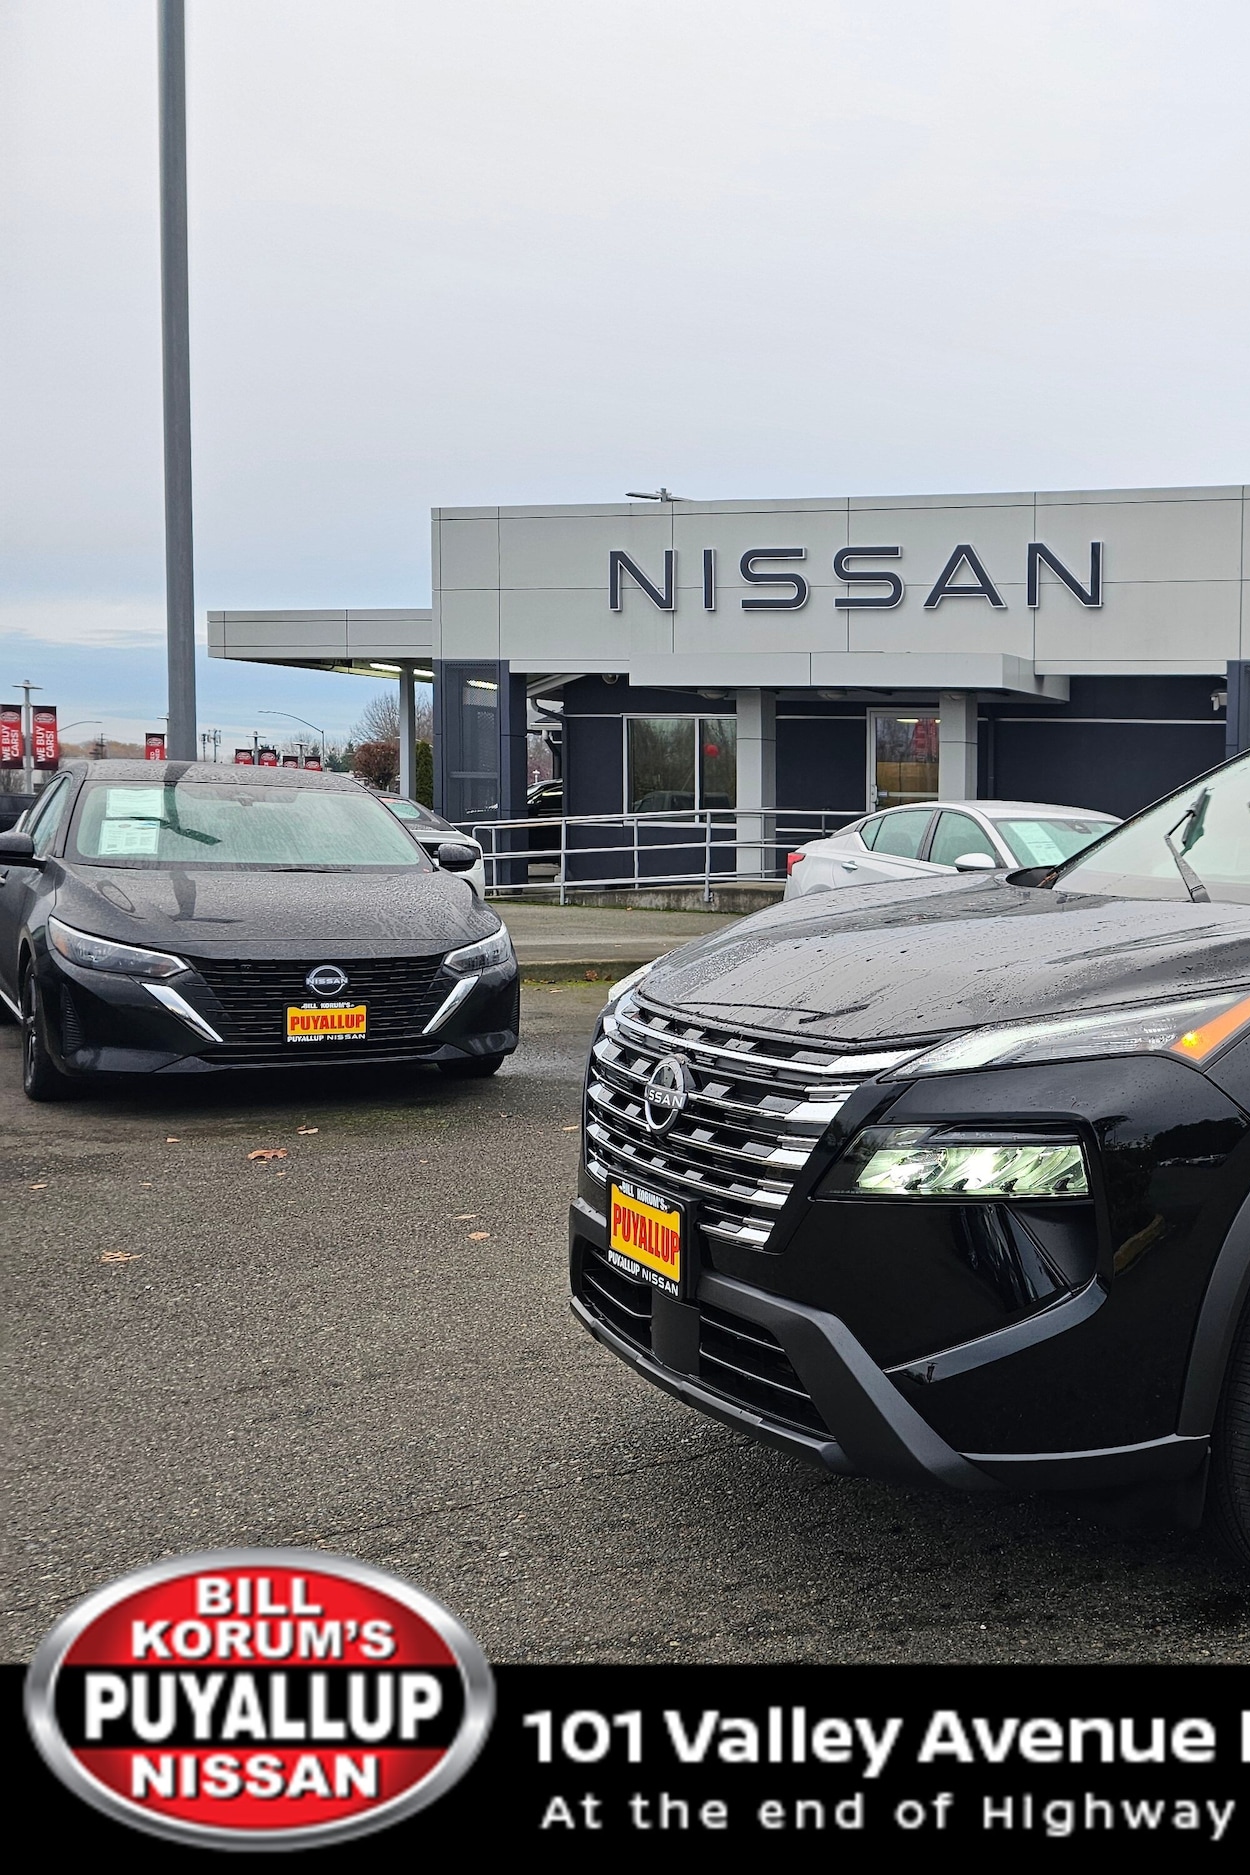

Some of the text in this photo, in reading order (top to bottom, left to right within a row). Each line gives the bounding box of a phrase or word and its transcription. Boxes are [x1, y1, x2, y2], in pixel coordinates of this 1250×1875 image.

[609, 540, 1105, 612] NISSAN
[1, 725, 10, 744] BUY
[11, 730, 19, 757] CARS!
[36, 726, 45, 745] BUY
[1, 746, 10, 761] WE
[46, 731, 54, 758] CARS!
[36, 747, 46, 762] WE
[290, 1014, 365, 1031] PUYALLUP
[287, 1033, 366, 1042] PUYALLUP NISSAN
[646, 1089, 684, 1108] SSAN
[613, 1203, 680, 1266] PUYALLUP
[608, 1250, 679, 1297] PUYALLUP NISSAN
